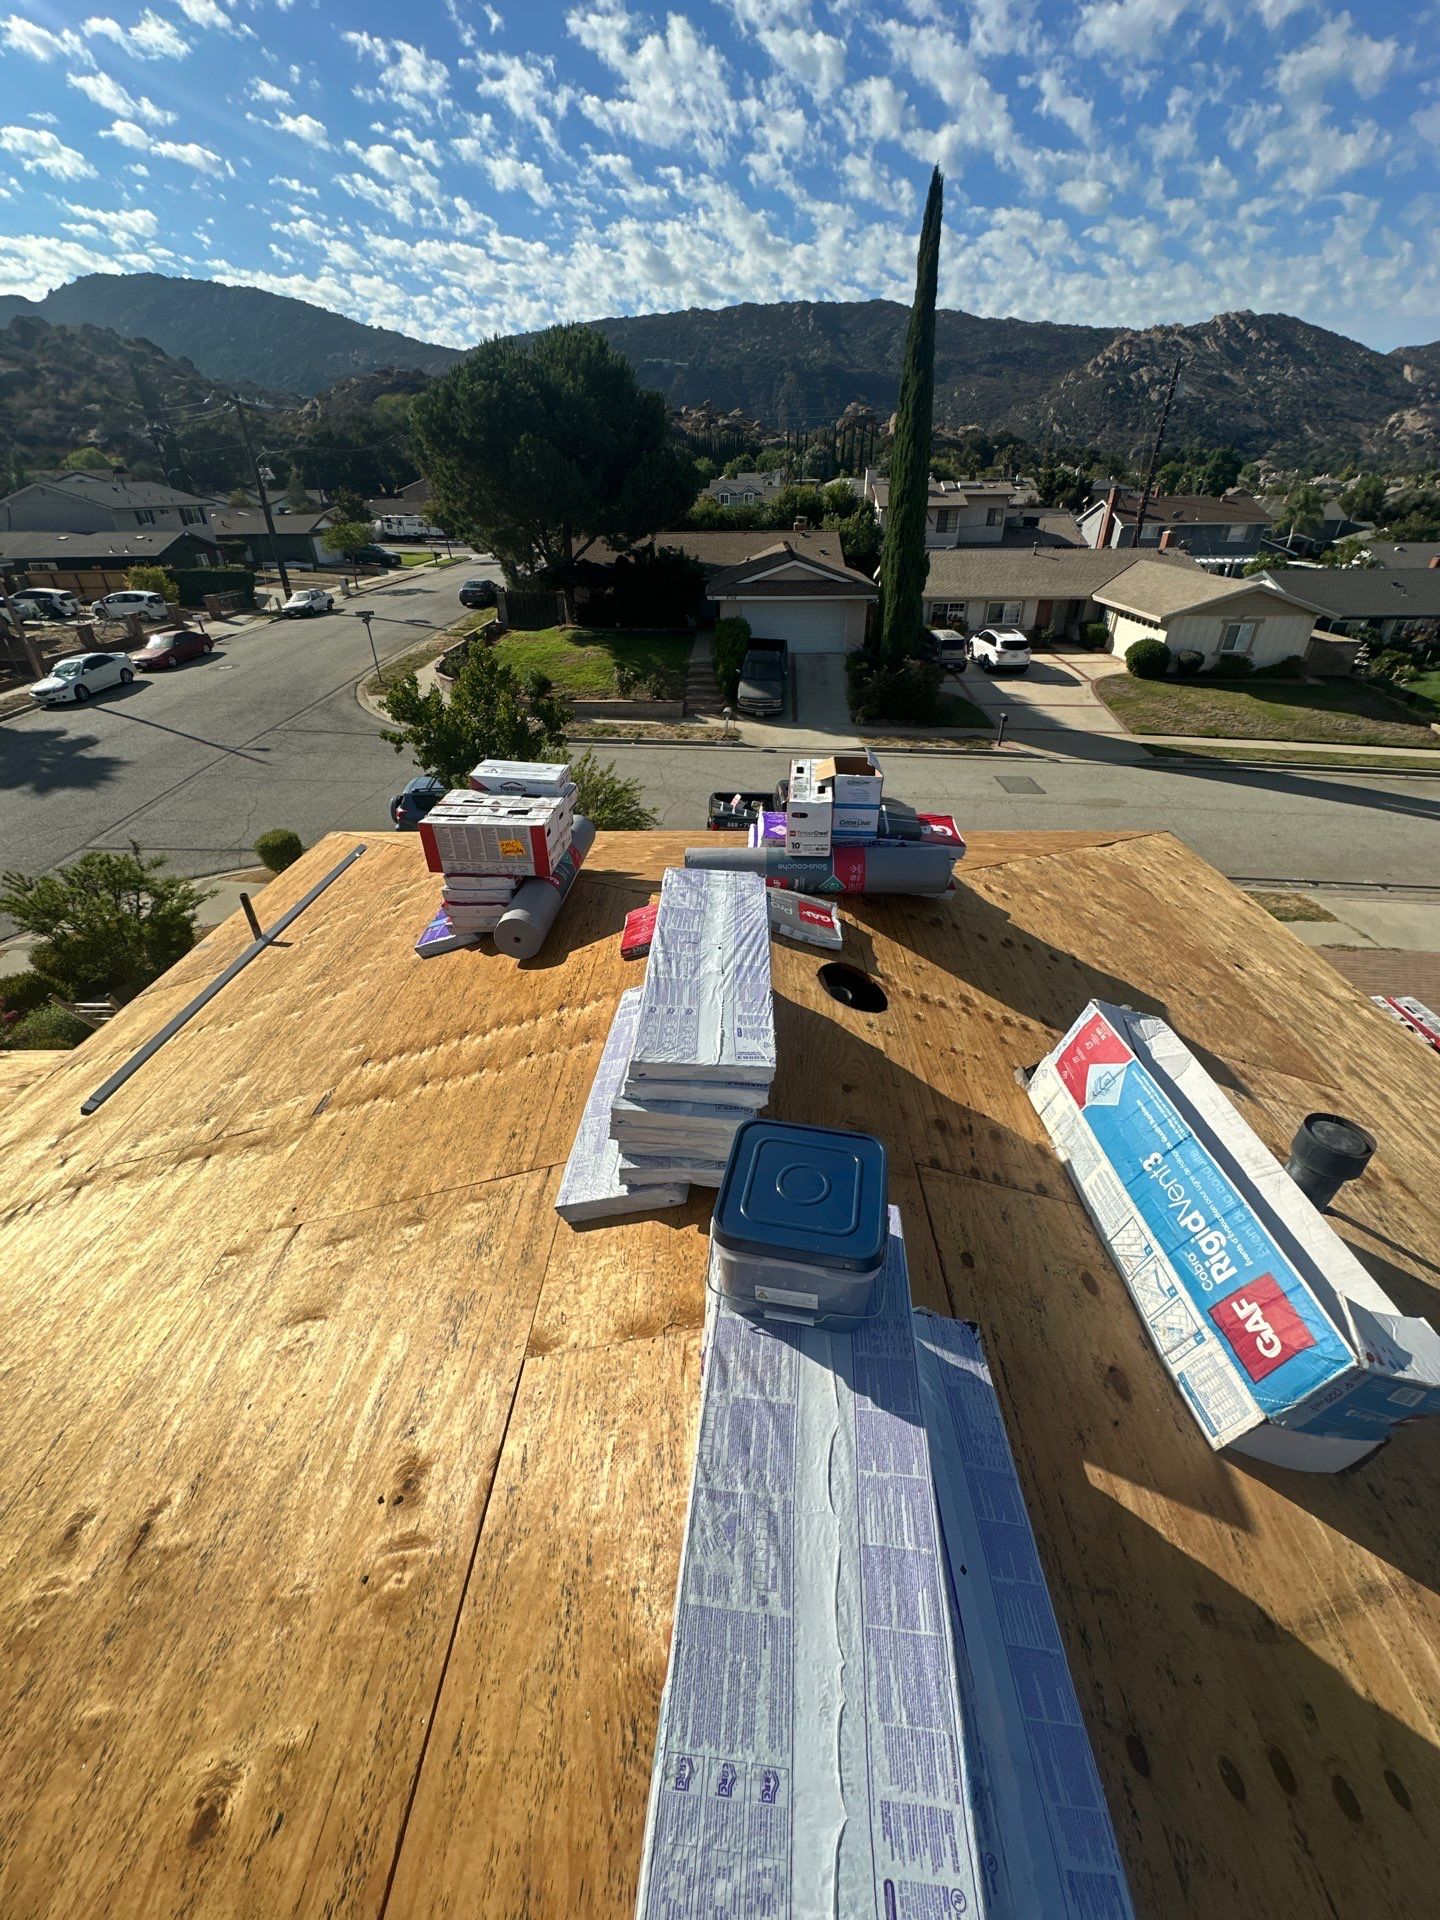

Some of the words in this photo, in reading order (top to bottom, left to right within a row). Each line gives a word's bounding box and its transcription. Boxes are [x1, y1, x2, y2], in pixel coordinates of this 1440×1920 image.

[778, 863, 828, 871] Sous-couche
[1200, 1190, 1213, 1204] pour
[1231, 1297, 1282, 1359] GAF
[717, 1762, 729, 1796] CRRC
[761, 1769, 772, 1804] CRRC
